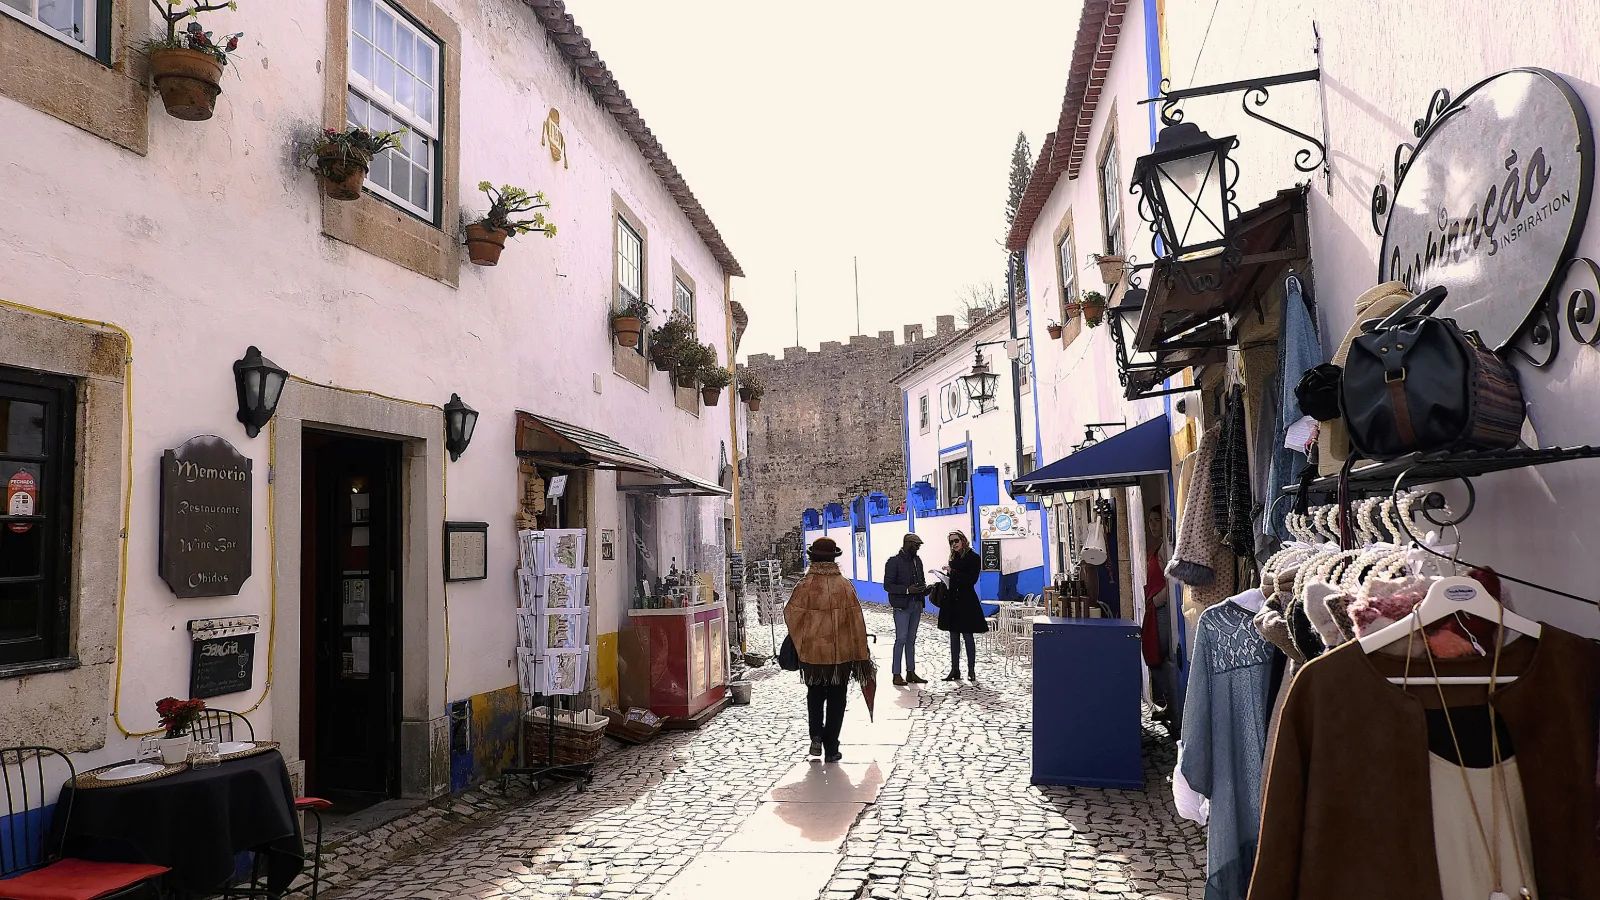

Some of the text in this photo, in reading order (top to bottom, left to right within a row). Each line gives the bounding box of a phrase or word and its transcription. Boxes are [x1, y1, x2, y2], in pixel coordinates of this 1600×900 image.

[1500, 191, 1571, 248] INSPIRATION
[178, 501, 240, 515] Restaurante
[180, 538, 237, 552] Wine Bar
